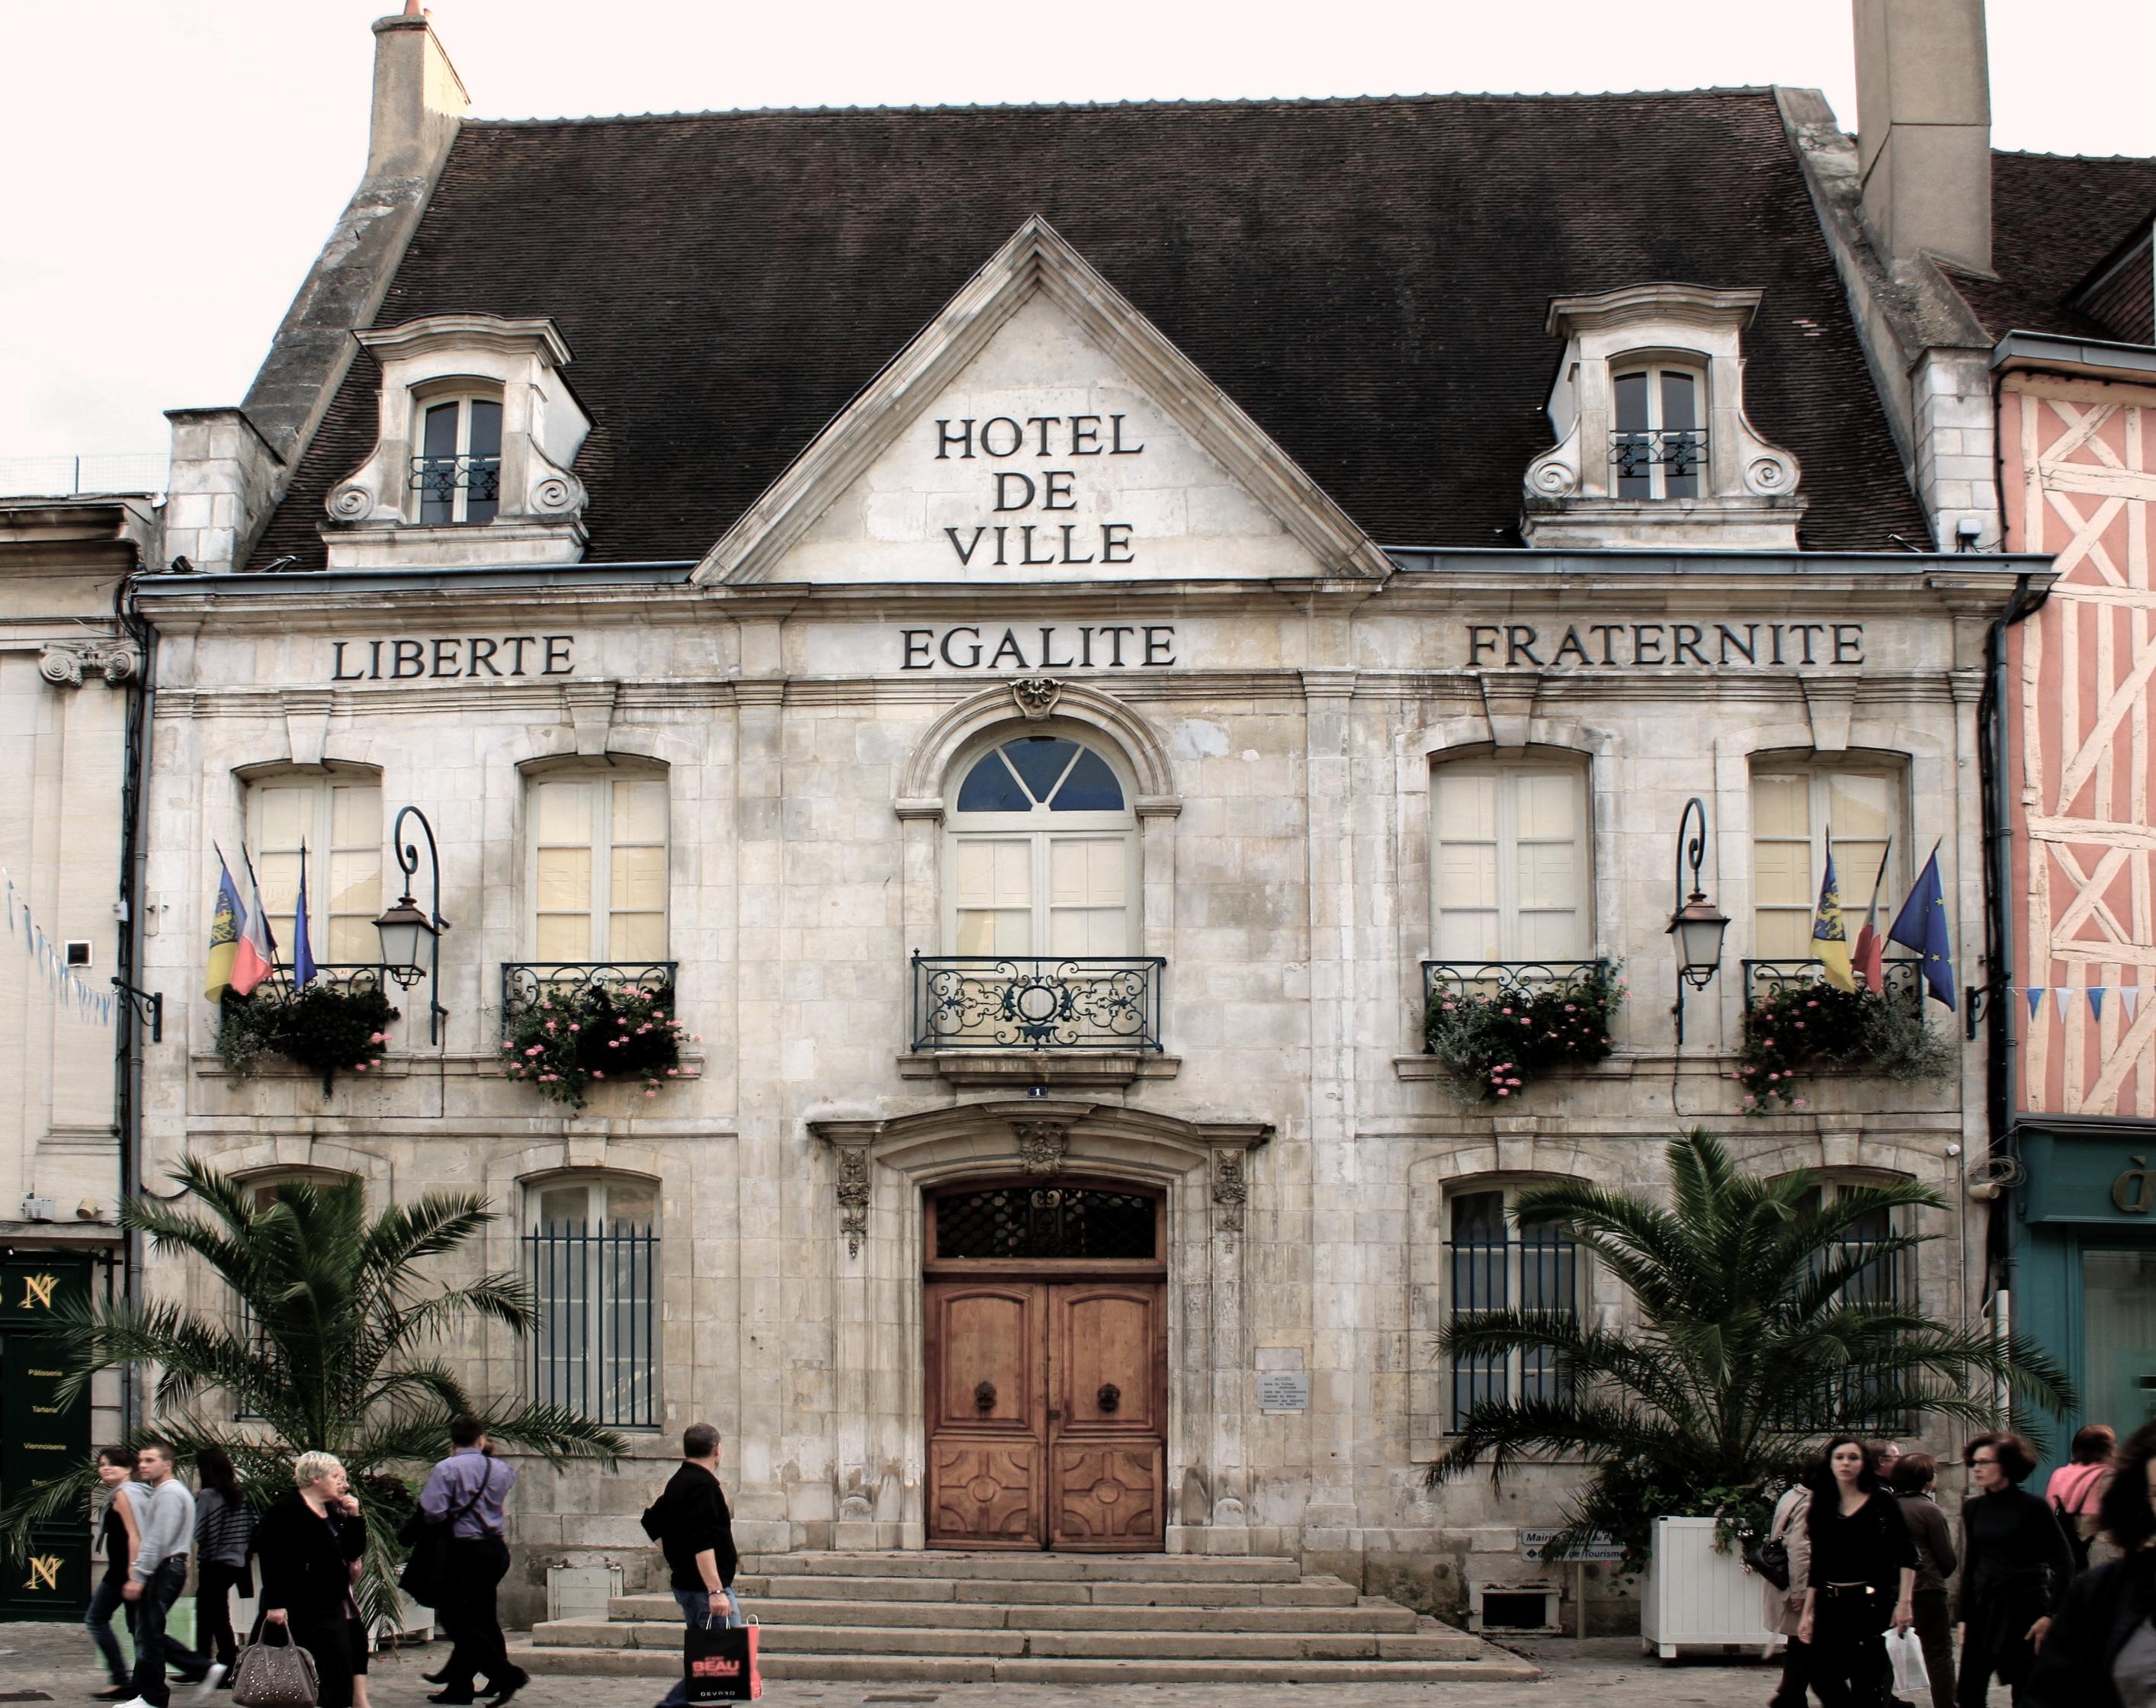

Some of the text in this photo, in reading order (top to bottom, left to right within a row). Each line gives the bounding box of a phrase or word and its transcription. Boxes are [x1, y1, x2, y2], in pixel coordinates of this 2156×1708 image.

[935, 414, 1145, 459] HOTEL
[993, 470, 1077, 512] DE
[944, 523, 1135, 566] VILLE
[331, 635, 576, 681] LIBERTE
[900, 625, 1176, 670] EGALITE
[1465, 624, 1866, 666] FRATERNITE
[27, 1369, 63, 1377] Pâtisserie
[31, 1405, 59, 1414] Tarterie
[23, 1442, 67, 1451] Viennoiserie
[692, 1660, 740, 1671] BEAU
